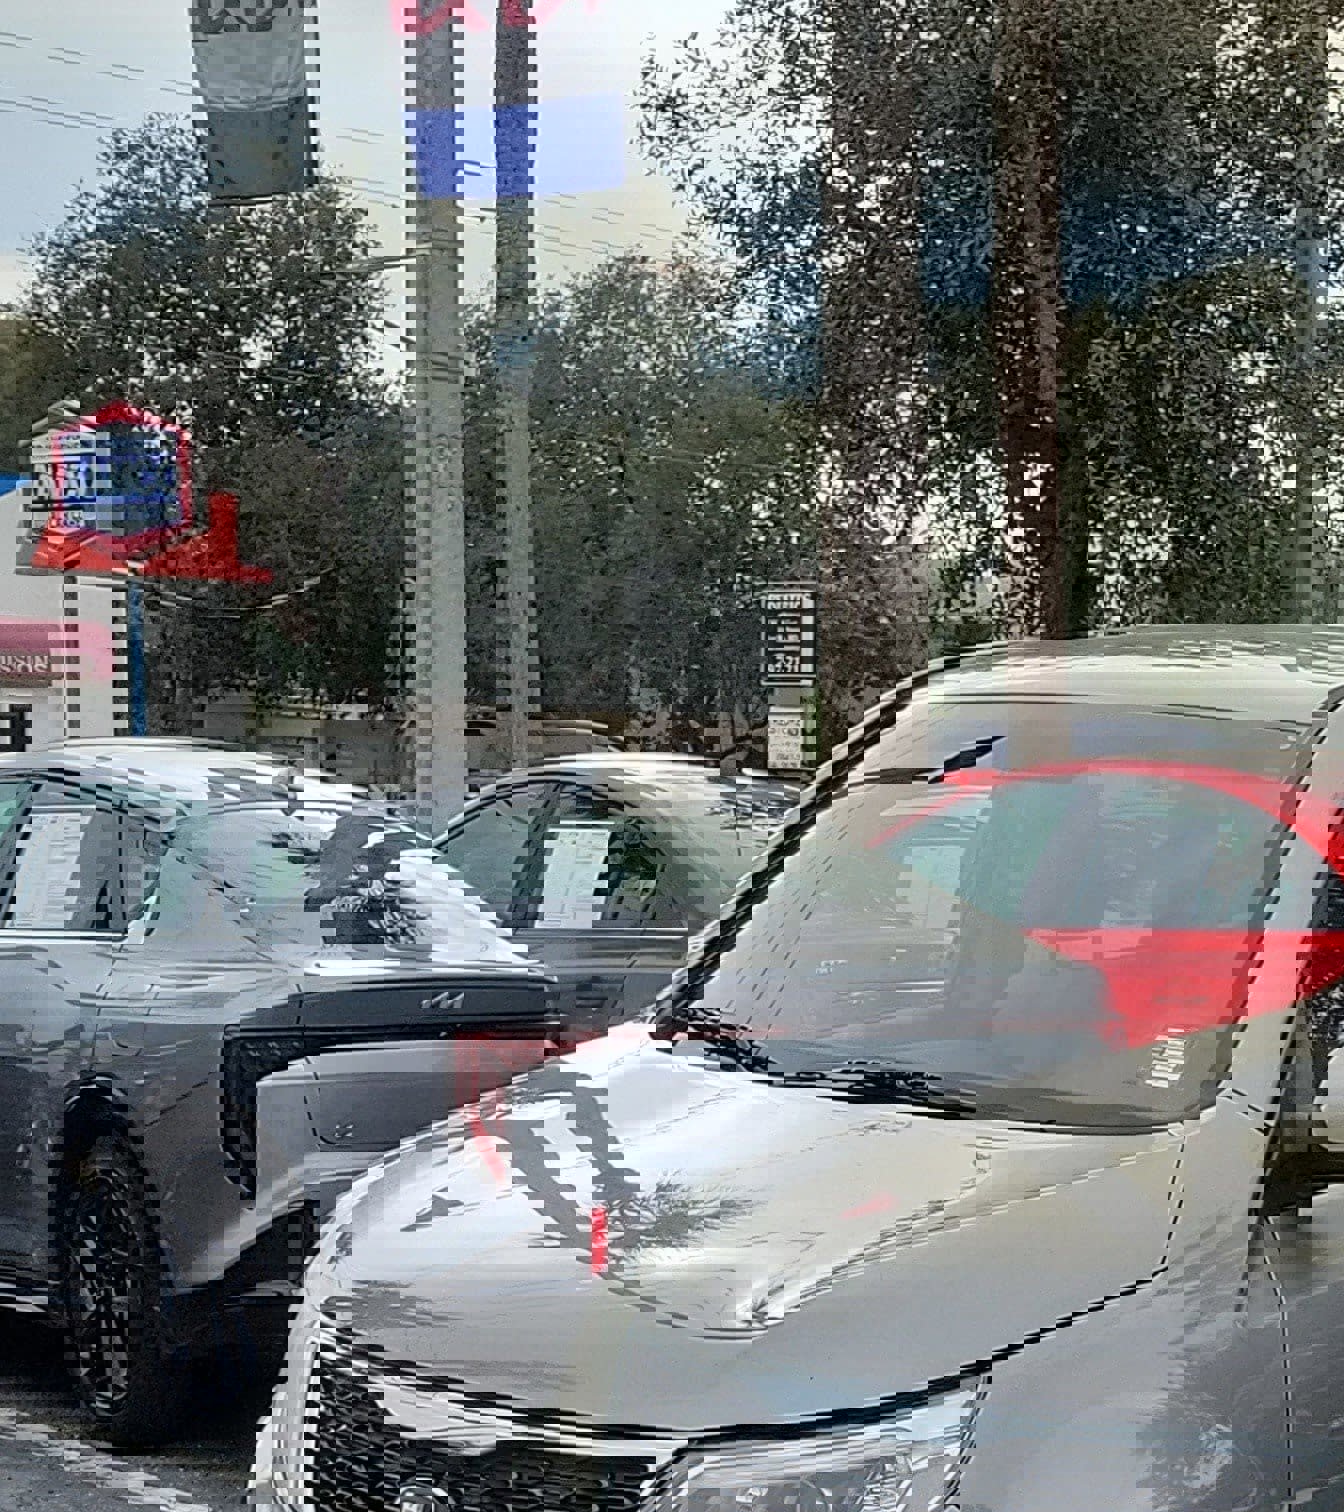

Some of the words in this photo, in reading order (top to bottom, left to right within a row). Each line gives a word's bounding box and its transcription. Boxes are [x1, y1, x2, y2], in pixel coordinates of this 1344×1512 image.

[79, 435, 160, 450] TRANSMISSIONS
[61, 456, 182, 500] AAMCO
[82, 508, 111, 521] TOTAL
[113, 508, 133, 521] CAR
[136, 507, 162, 520] CARE
[852, 986, 928, 1009] KIA
